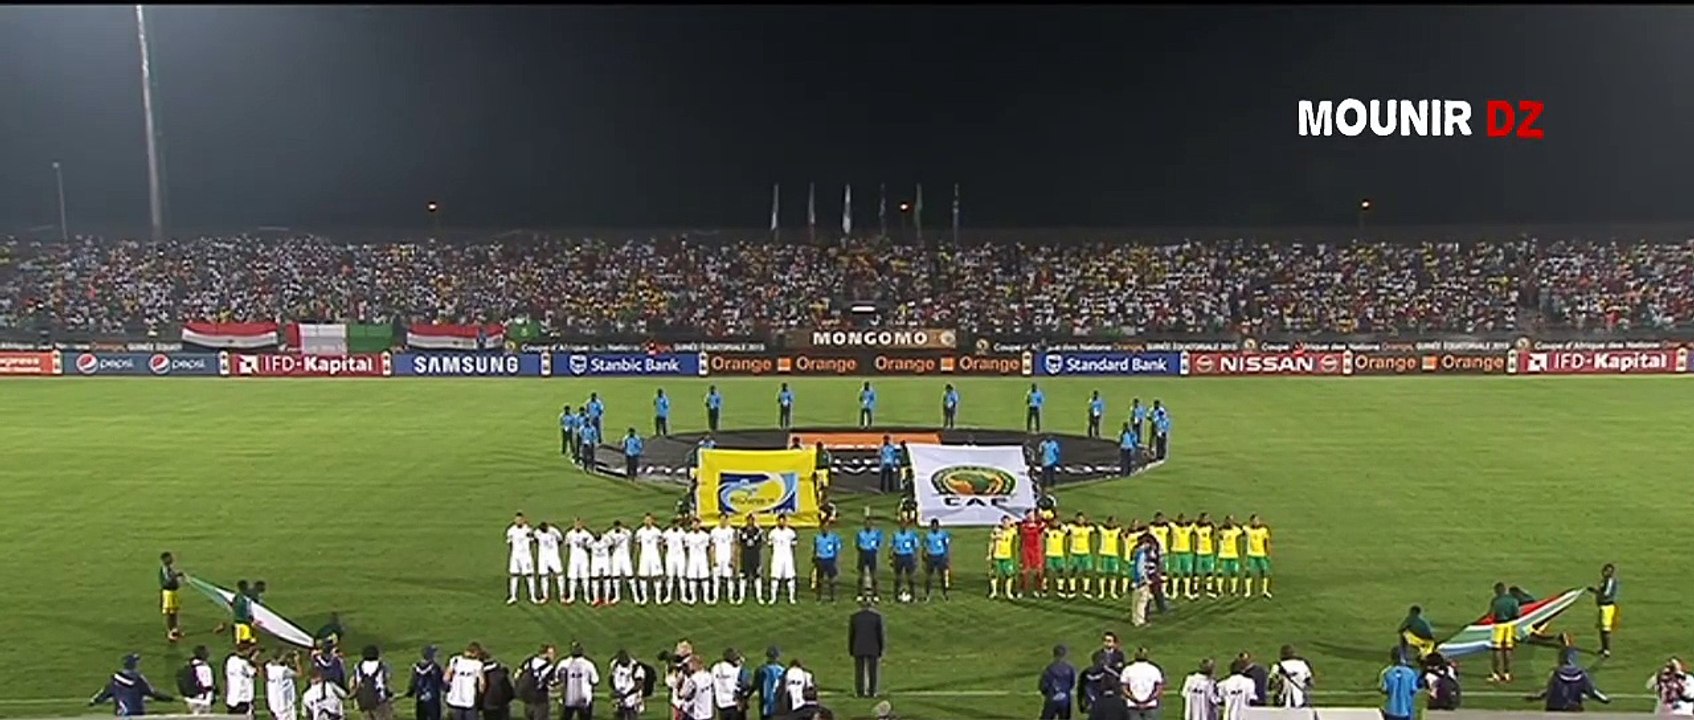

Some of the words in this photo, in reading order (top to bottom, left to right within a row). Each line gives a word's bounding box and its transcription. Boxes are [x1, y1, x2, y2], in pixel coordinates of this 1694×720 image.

[813, 331, 928, 346] MONGOMO
[100, 358, 134, 369] pepsi
[172, 358, 205, 369] pepsi
[414, 353, 519, 373] SAMSUNG
[591, 356, 642, 372] Stanbic
[646, 356, 680, 372] Bank
[711, 355, 772, 374] Orange
[797, 355, 857, 374] Orange
[874, 355, 935, 374] Orange
[959, 355, 1020, 374] Orange
[1066, 357, 1128, 372] Standard
[1132, 357, 1167, 372] Bank
[1220, 357, 1314, 372] NISSAN
[1355, 353, 1416, 372] Orange
[1442, 352, 1504, 372] Orange
